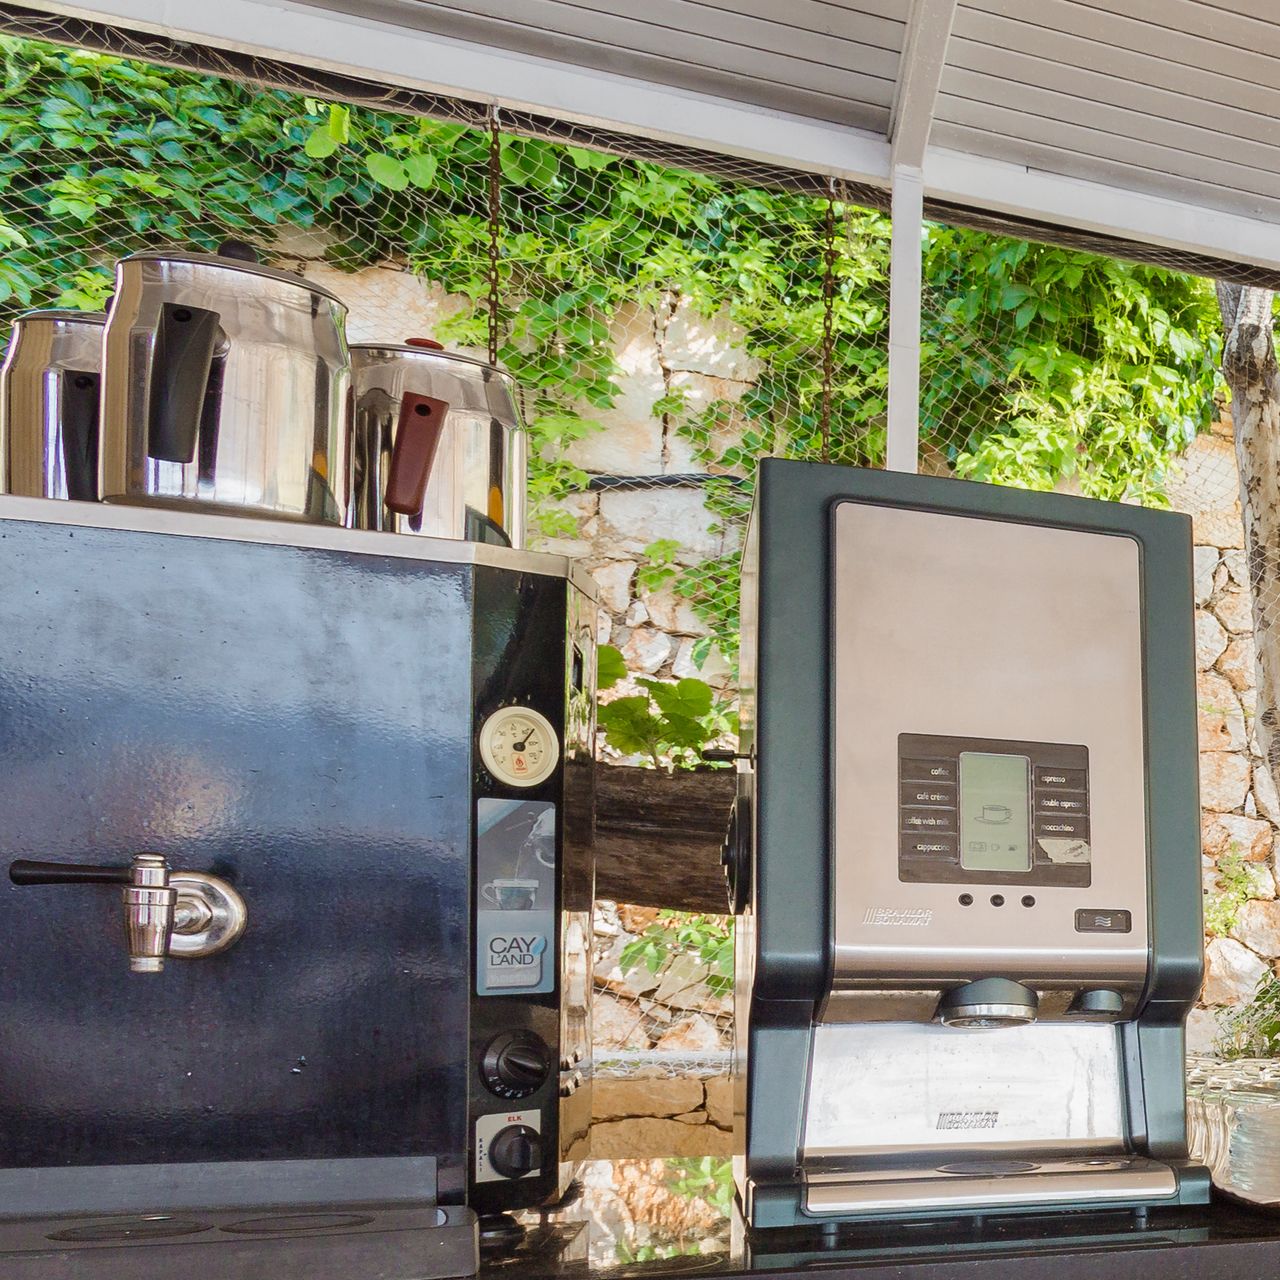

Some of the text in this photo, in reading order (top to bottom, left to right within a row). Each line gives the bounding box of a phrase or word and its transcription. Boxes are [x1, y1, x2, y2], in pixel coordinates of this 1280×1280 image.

[930, 767, 950, 776] coffee
[1041, 775, 1066, 784] espresso
[916, 792, 930, 800] café
[1041, 799, 1060, 807] double
[905, 817, 922, 825] coffee
[922, 818, 936, 826] with
[916, 843, 951, 853] cappuccino
[490, 953, 535, 966] LAND
